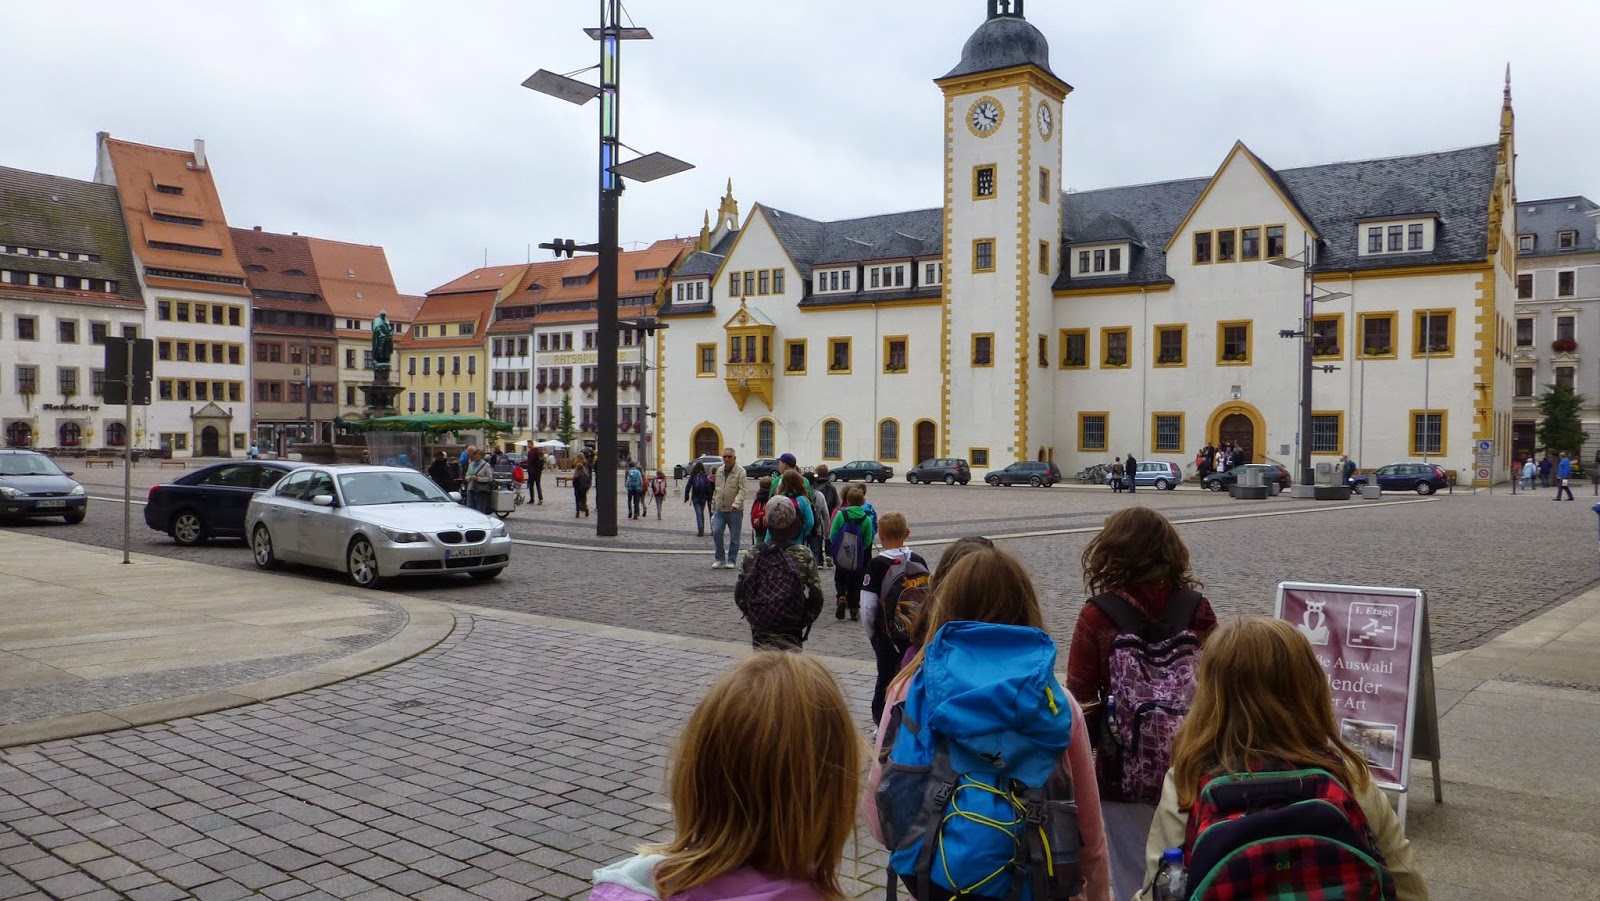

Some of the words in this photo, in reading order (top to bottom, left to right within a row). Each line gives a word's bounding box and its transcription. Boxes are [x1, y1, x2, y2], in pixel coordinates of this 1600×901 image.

[554, 352, 627, 365] RATSAPOE
[1366, 606, 1394, 618] Etage
[1333, 657, 1393, 674] Auswahl
[1344, 696, 1366, 710] Art
